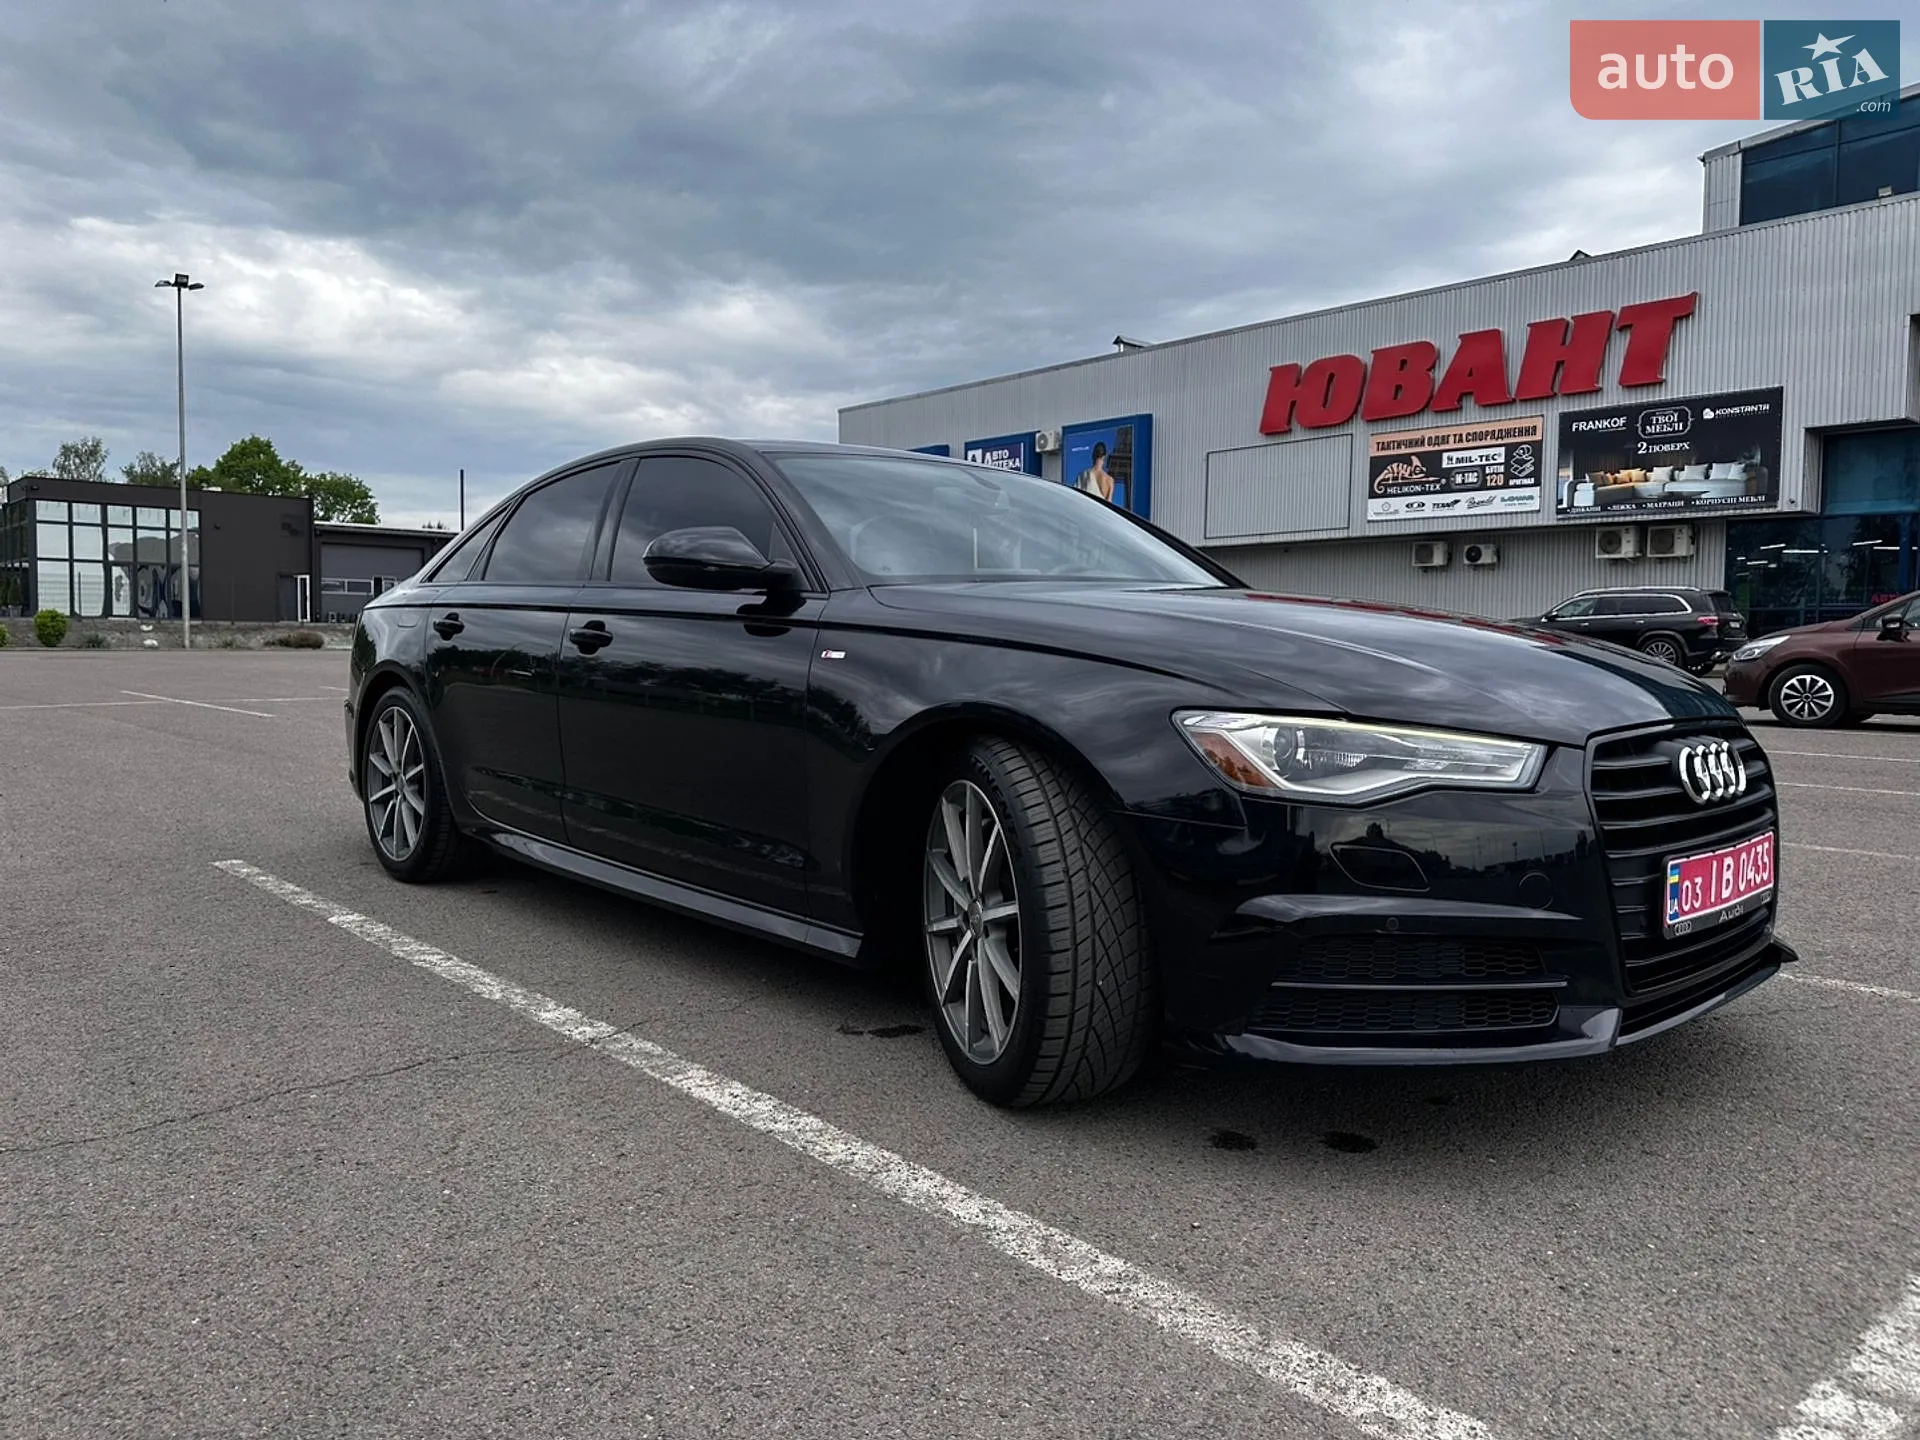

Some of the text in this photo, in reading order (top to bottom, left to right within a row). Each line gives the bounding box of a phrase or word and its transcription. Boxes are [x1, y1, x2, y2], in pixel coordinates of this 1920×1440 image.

[1259, 291, 1698, 434] ЮВАНТ
[1571, 416, 1628, 432] FRANKOF
[1375, 425, 1537, 452] ТАКТИЧНИЙ ОДЯГ ТА СПОРЯДЖЕННЯ
[1637, 441, 1691, 454] 2 ПОВЕРХ
[1486, 474, 1504, 486] 120
[1668, 897, 1679, 914] UA
[1681, 876, 1703, 912] 03
[1738, 841, 1770, 892] 0435
[1718, 904, 1744, 923] Audi
